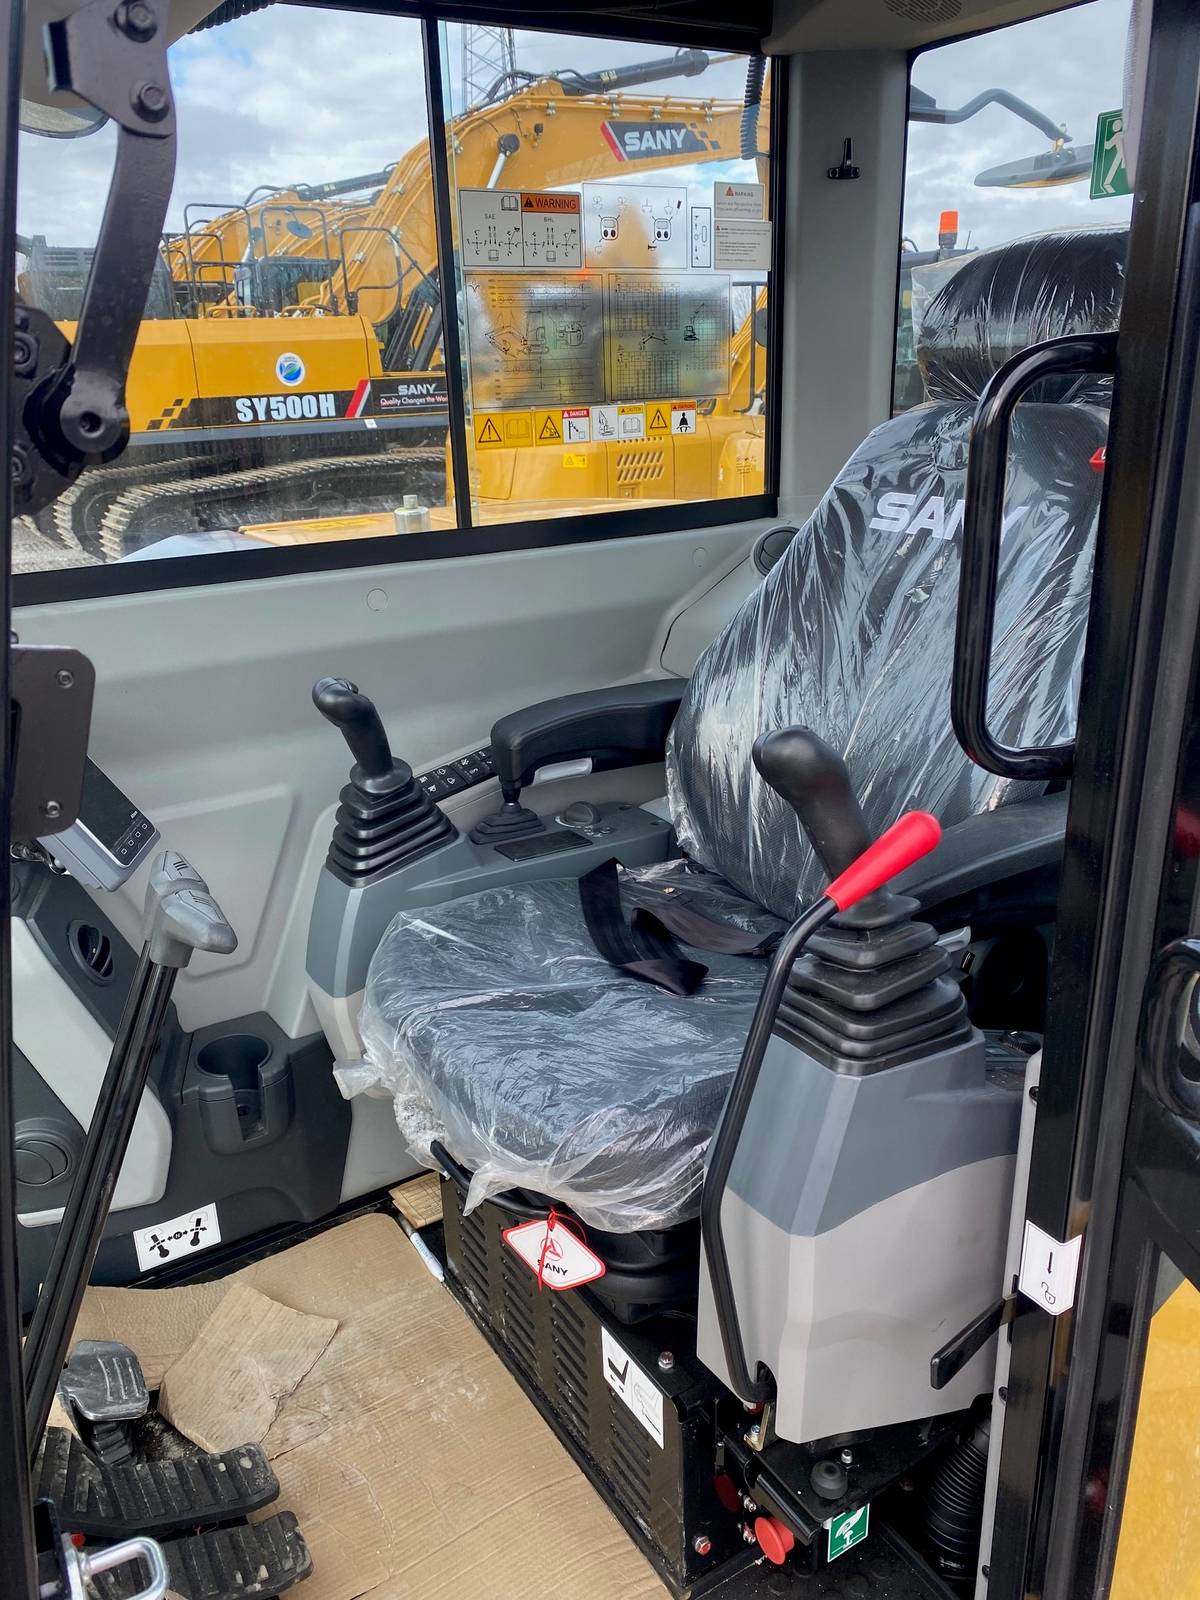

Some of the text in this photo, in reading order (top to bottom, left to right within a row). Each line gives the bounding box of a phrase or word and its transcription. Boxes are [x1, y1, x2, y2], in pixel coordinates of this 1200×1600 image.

[624, 129, 687, 152] SANY
[535, 199, 576, 210] WARNING
[397, 383, 436, 396] SANY
[235, 393, 336, 422] SY500H
[380, 396, 401, 406] Quality
[401, 395, 426, 405] Changes
[869, 491, 1030, 546] SA
